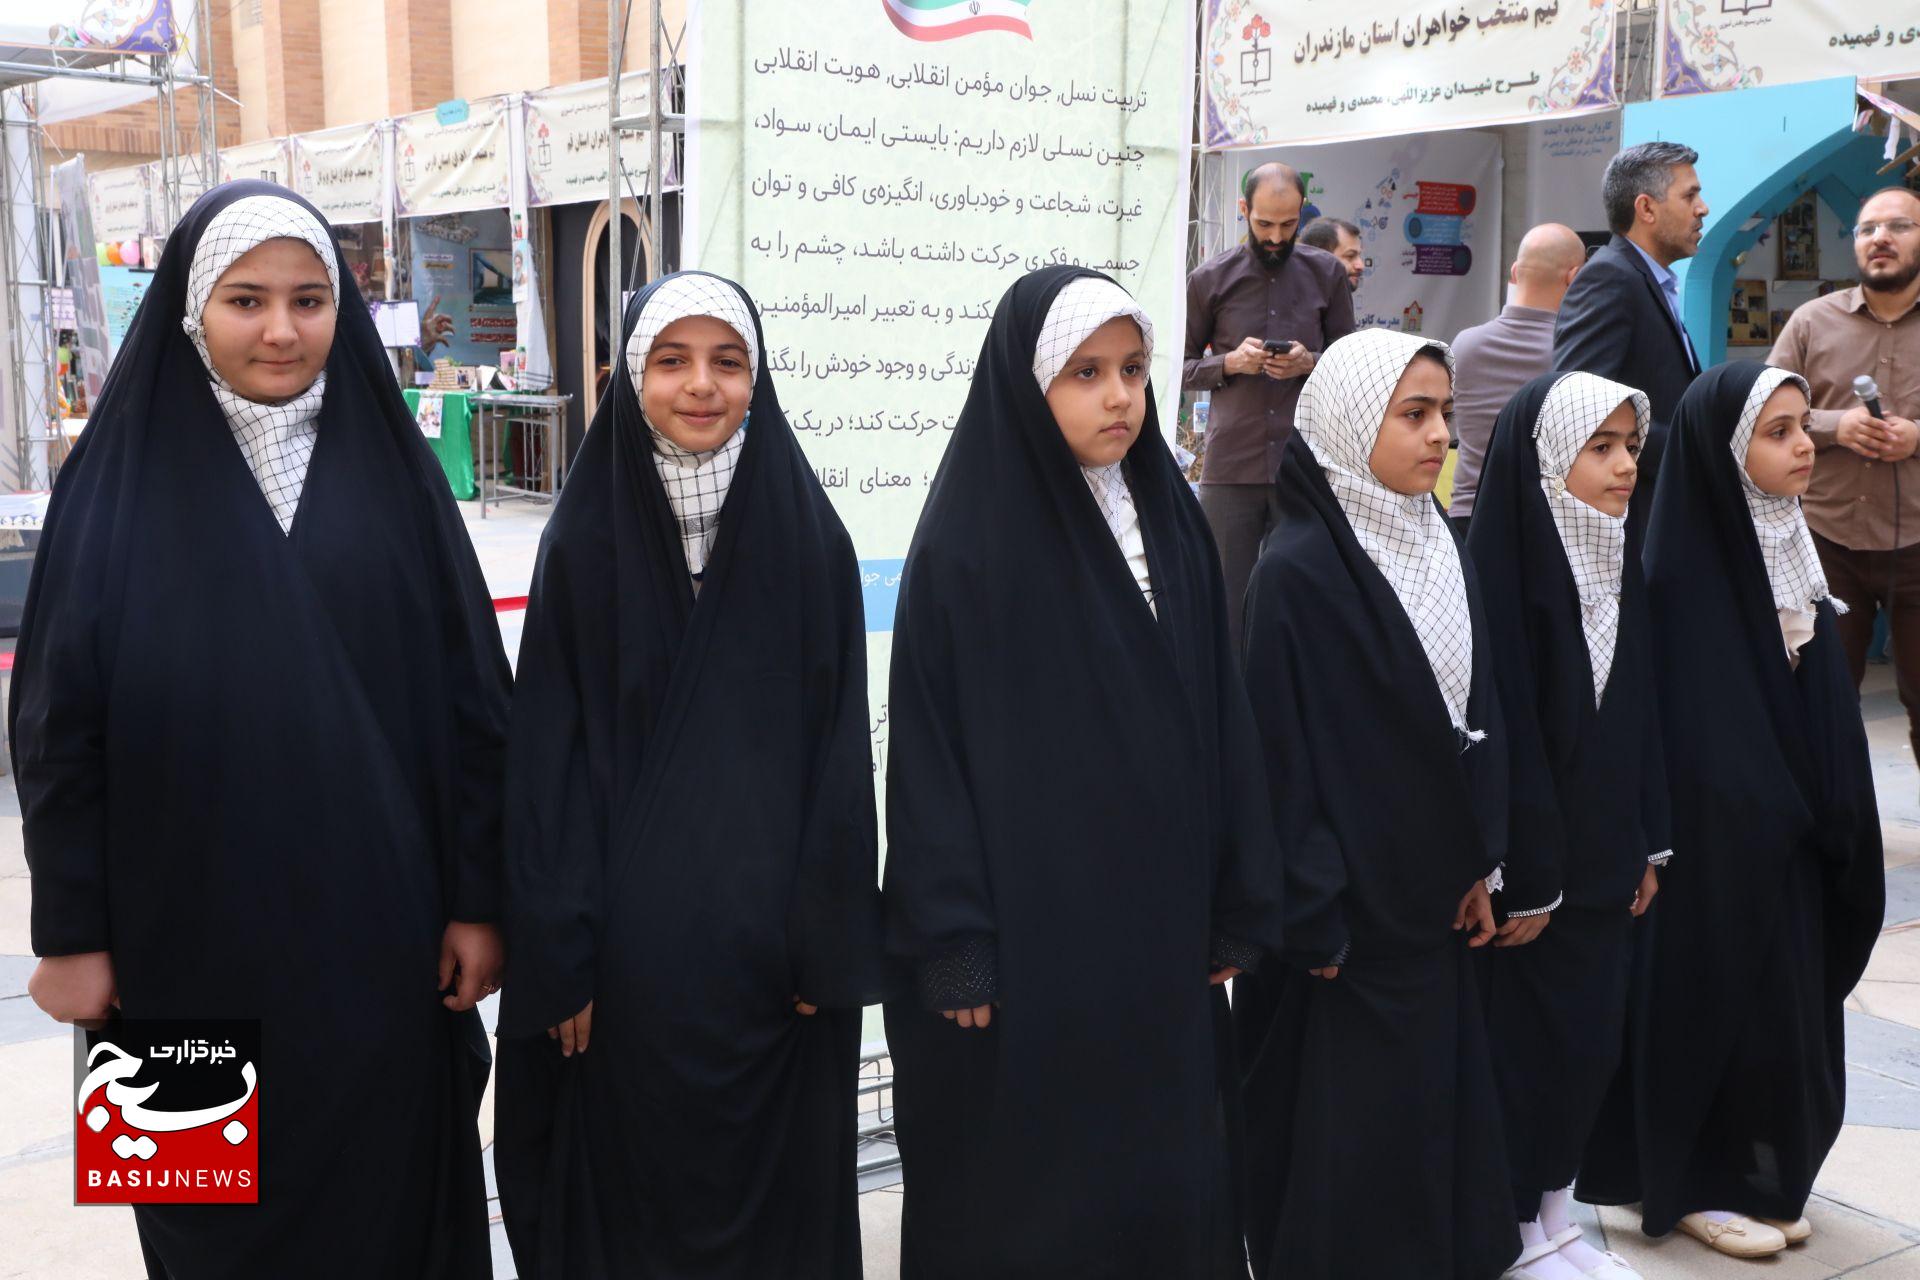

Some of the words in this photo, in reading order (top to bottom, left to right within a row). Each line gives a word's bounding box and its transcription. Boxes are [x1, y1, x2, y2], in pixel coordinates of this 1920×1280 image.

[1402, 6, 1471, 48] خواهران
[1476, 1, 1529, 35] منتخب
[1294, 25, 1356, 64] مازندران
[1359, 16, 1400, 54] استان
[1829, 24, 1881, 50] فهمیده
[1884, 31, 1894, 47] و
[754, 46, 818, 74] انقلابی
[824, 57, 880, 84] هویت
[954, 71, 1005, 98] مؤمن
[1009, 74, 1052, 104] جوان
[1444, 77, 1492, 100] شهیدان
[1494, 70, 1540, 94] طرح
[1101, 88, 1147, 113] تربیت
[1306, 95, 1338, 115] فهمیده
[1340, 101, 1346, 113] و
[1347, 95, 1384, 112] محمدی
[754, 107, 811, 137] سواد،
[817, 113, 877, 145] ایمان،
[881, 123, 949, 152] بایستی
[953, 129, 1006, 157] داریم:
[1009, 132, 1039, 161] لازم
[1042, 135, 1093, 162] نسلی
[1096, 145, 1145, 171] چنین
[751, 168, 792, 198] توان
[797, 181, 807, 199] و
[813, 173, 857, 202] کافی
[929, 184, 1011, 213] خودباوری،
[1015, 197, 1024, 215] و
[1029, 191, 1092, 218] شجاعت
[1096, 198, 1143, 223] غیرت،
[750, 236, 772, 258] به
[776, 230, 789, 259] را
[794, 234, 846, 265] چشم
[853, 236, 905, 265] باشد،
[910, 241, 965, 262] داشته
[970, 243, 1020, 270] حرکت
[1024, 247, 1067, 272] فکری
[870, 300, 916, 323] تعبیر
[921, 302, 940, 324] به
[945, 308, 954, 325] و
[958, 300, 994, 320] کند
[801, 350, 811, 379] را
[815, 353, 872, 380] خودش
[875, 359, 915, 379] وجود
[918, 361, 927, 381] و
[793, 409, 823, 437] یک
[825, 415, 844, 437] در
[888, 410, 938, 437] حرکت
[816, 466, 849, 488] انقلا
[860, 466, 912, 494] معنای
